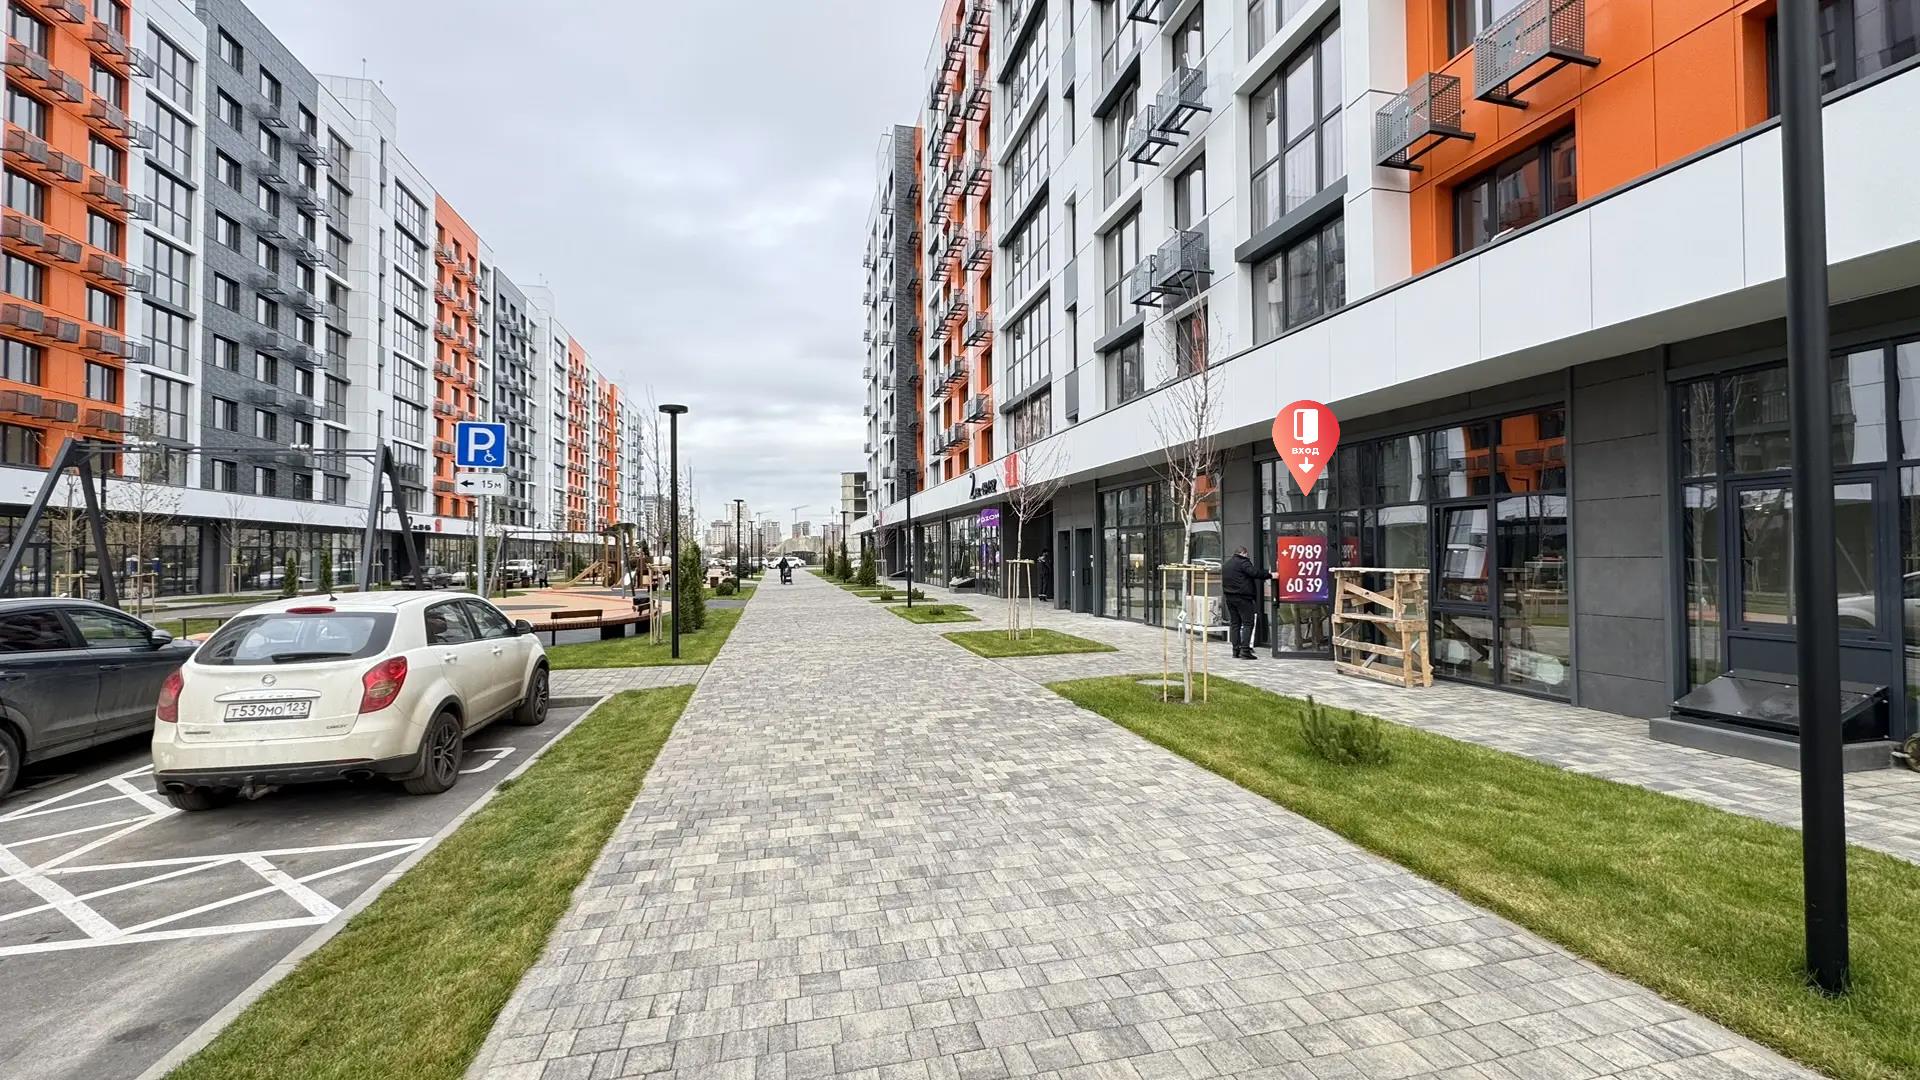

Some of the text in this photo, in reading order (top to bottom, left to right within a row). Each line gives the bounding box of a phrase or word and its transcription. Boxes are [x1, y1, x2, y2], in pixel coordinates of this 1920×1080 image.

[467, 427, 496, 462] P
[1281, 545, 1321, 559] +7989
[1297, 561, 1322, 576] 297
[1286, 578, 1322, 592] 60 39
[286, 702, 306, 712] 123
